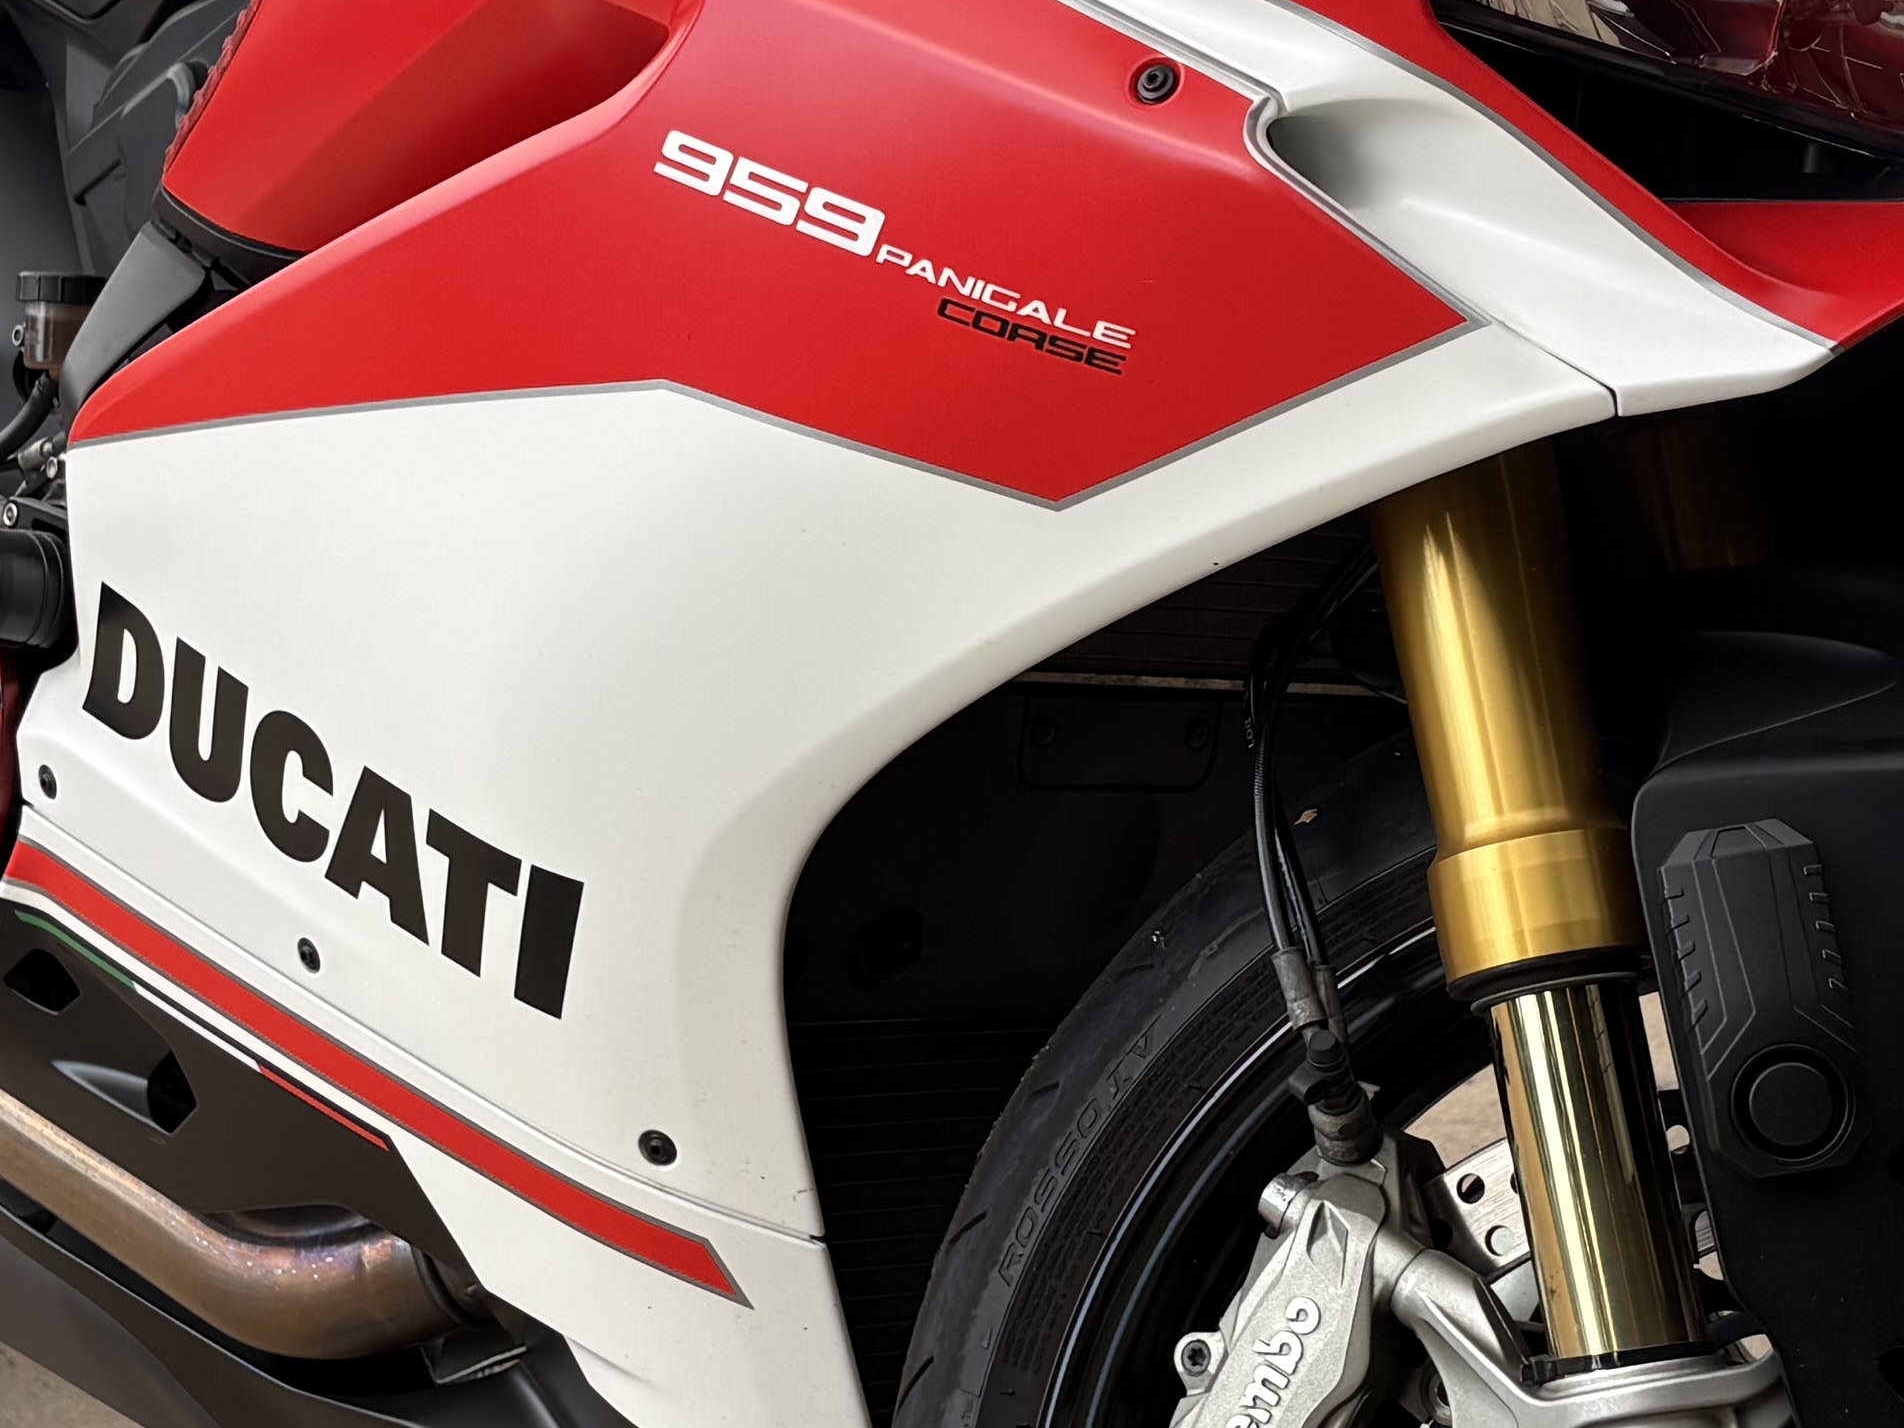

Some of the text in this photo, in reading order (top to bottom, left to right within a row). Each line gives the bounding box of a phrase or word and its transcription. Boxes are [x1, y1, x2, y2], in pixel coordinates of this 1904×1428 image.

[653, 129, 1137, 349] 959 PANIGALE
[937, 296, 1127, 375] CORSE
[82, 581, 585, 1020] DUCATI
[998, 1095, 1101, 1290] ROSSO
